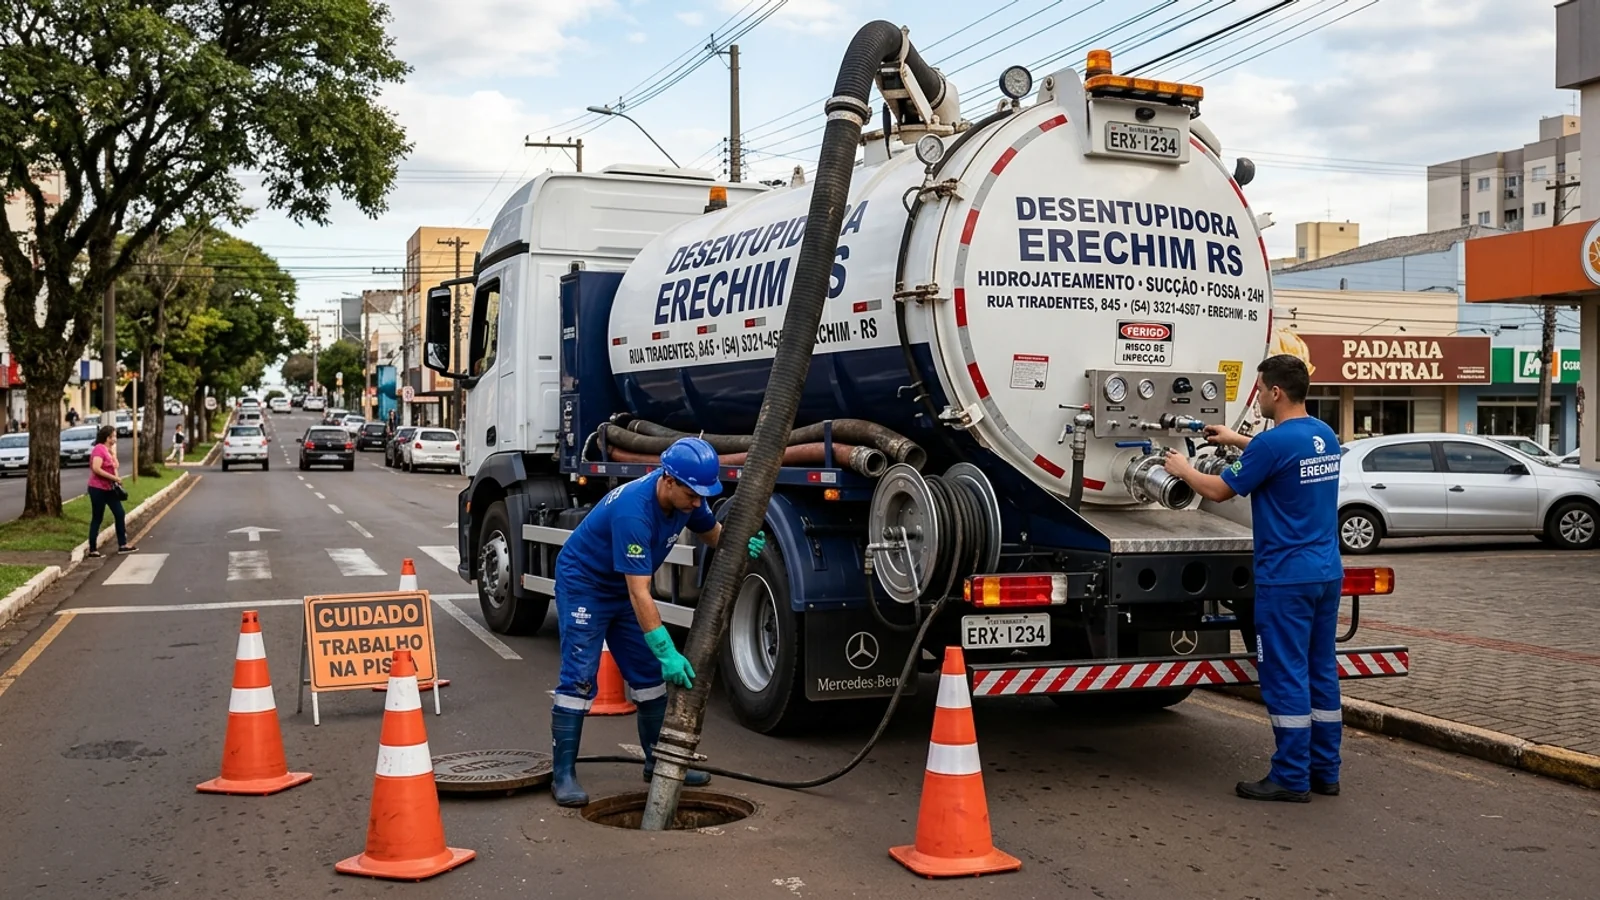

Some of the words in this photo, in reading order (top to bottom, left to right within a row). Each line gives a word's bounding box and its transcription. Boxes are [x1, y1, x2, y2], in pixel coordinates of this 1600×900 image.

[1016, 196, 1239, 239] DESENTUPIDORA
[665, 200, 869, 276] DESENTUPIDA
[1018, 228, 1197, 271] ERECHIM
[1207, 240, 1244, 277] RS
[654, 257, 792, 325] ERECHIM
[978, 270, 1135, 291] HIDROJATEAMENTO
[1146, 276, 1198, 298] SUCÇÃO
[1207, 281, 1241, 300] FOSSA
[1247, 288, 1264, 303] 24H
[987, 295, 1014, 308] RUA
[1017, 295, 1098, 313] TIRADENTES,
[1100, 297, 1121, 311] 845
[1130, 300, 1151, 316] (54)
[1208, 305, 1244, 320] ERECHIM
[1248, 309, 1258, 321] RS
[629, 349, 646, 364] RUA
[860, 317, 878, 339] RS
[1342, 340, 1444, 359] PADARIA
[1341, 361, 1444, 380] CENTRAL
[318, 603, 419, 628] CUIDADO
[319, 633, 423, 656] TRABALHO
[329, 660, 357, 678] NA
[363, 657, 419, 676] PIS
[817, 675, 907, 691] Mercedes-Ben
